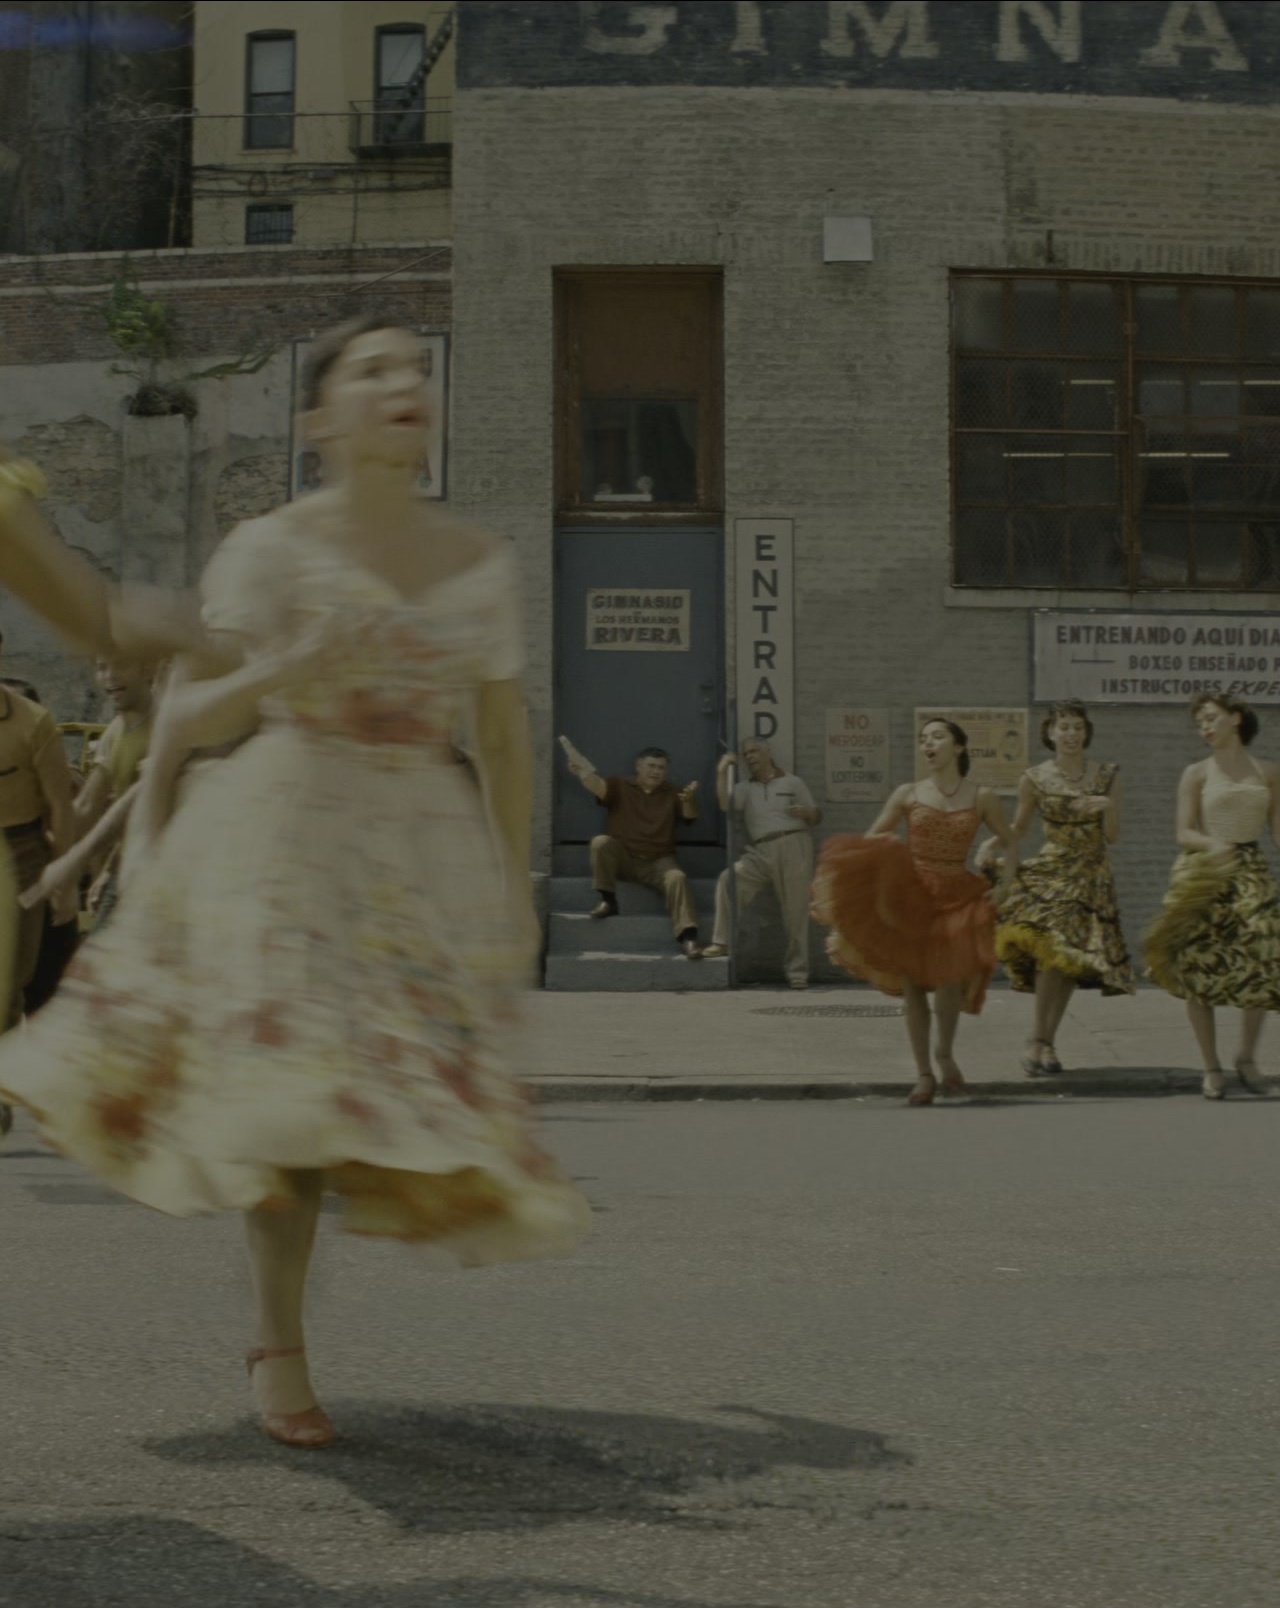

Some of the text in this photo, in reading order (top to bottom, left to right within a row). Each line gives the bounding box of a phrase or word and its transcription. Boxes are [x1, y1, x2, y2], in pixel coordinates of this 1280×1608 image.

[592, 595, 683, 609] GIMNASIO
[596, 616, 680, 625] LOS HERMANOS
[592, 627, 682, 644] RIVERA
[752, 534, 779, 739] ENTRAD
[1056, 625, 1186, 645] ENTRENANDO
[1192, 623, 1245, 646] AQUÍ
[1128, 655, 1182, 671] BOXEO
[1189, 653, 1267, 673] ENSEÑADO
[1102, 678, 1221, 695] INSTRUCTORES
[843, 714, 870, 730] NO
[849, 756, 864, 768] NO
